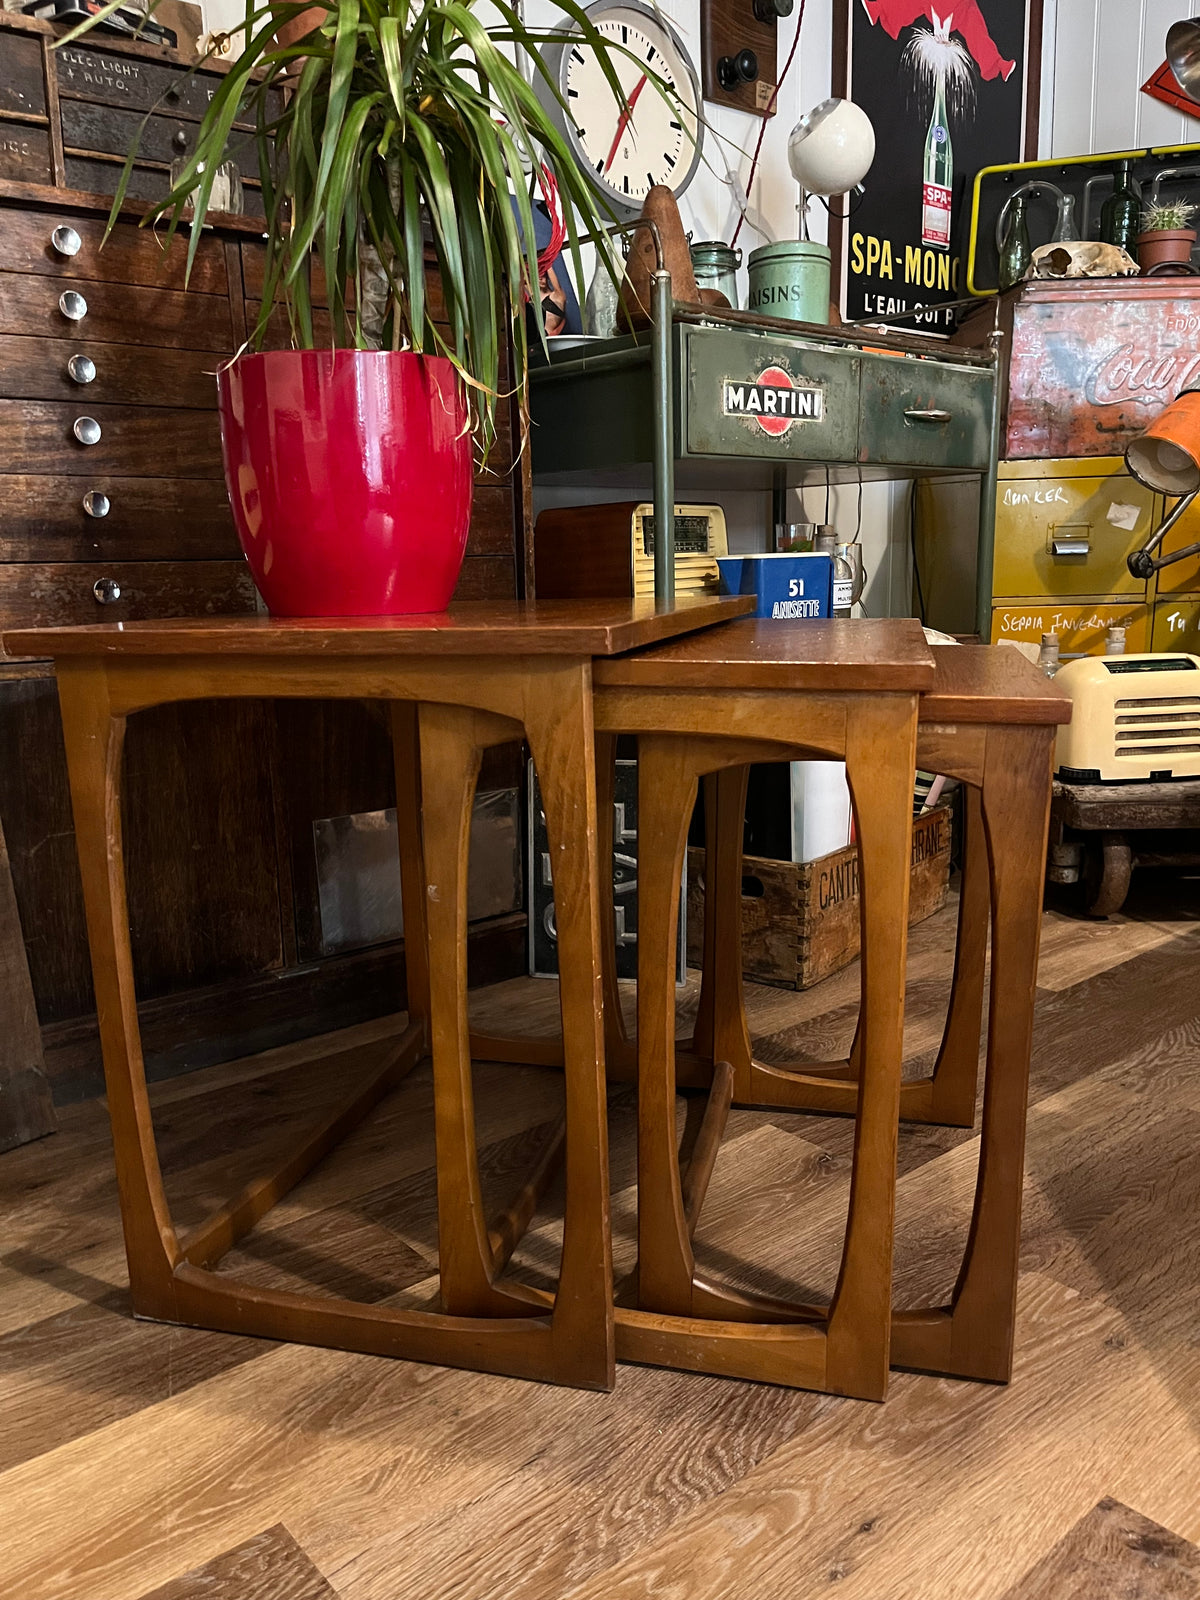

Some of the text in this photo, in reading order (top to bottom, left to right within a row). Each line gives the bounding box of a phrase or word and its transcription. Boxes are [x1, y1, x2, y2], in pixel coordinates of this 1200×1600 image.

[101, 60, 139, 78] LIGHT
[84, 72, 129, 91] AUTO.
[927, 187, 947, 204] SPA
[750, 285, 800, 307] AISINS
[727, 385, 821, 416] MARTINI
[788, 578, 805, 597] 51
[772, 599, 820, 619] ANISETTE
[1001, 613, 1043, 633] SEPPIA
[820, 821, 945, 910] CANTR HRANE
